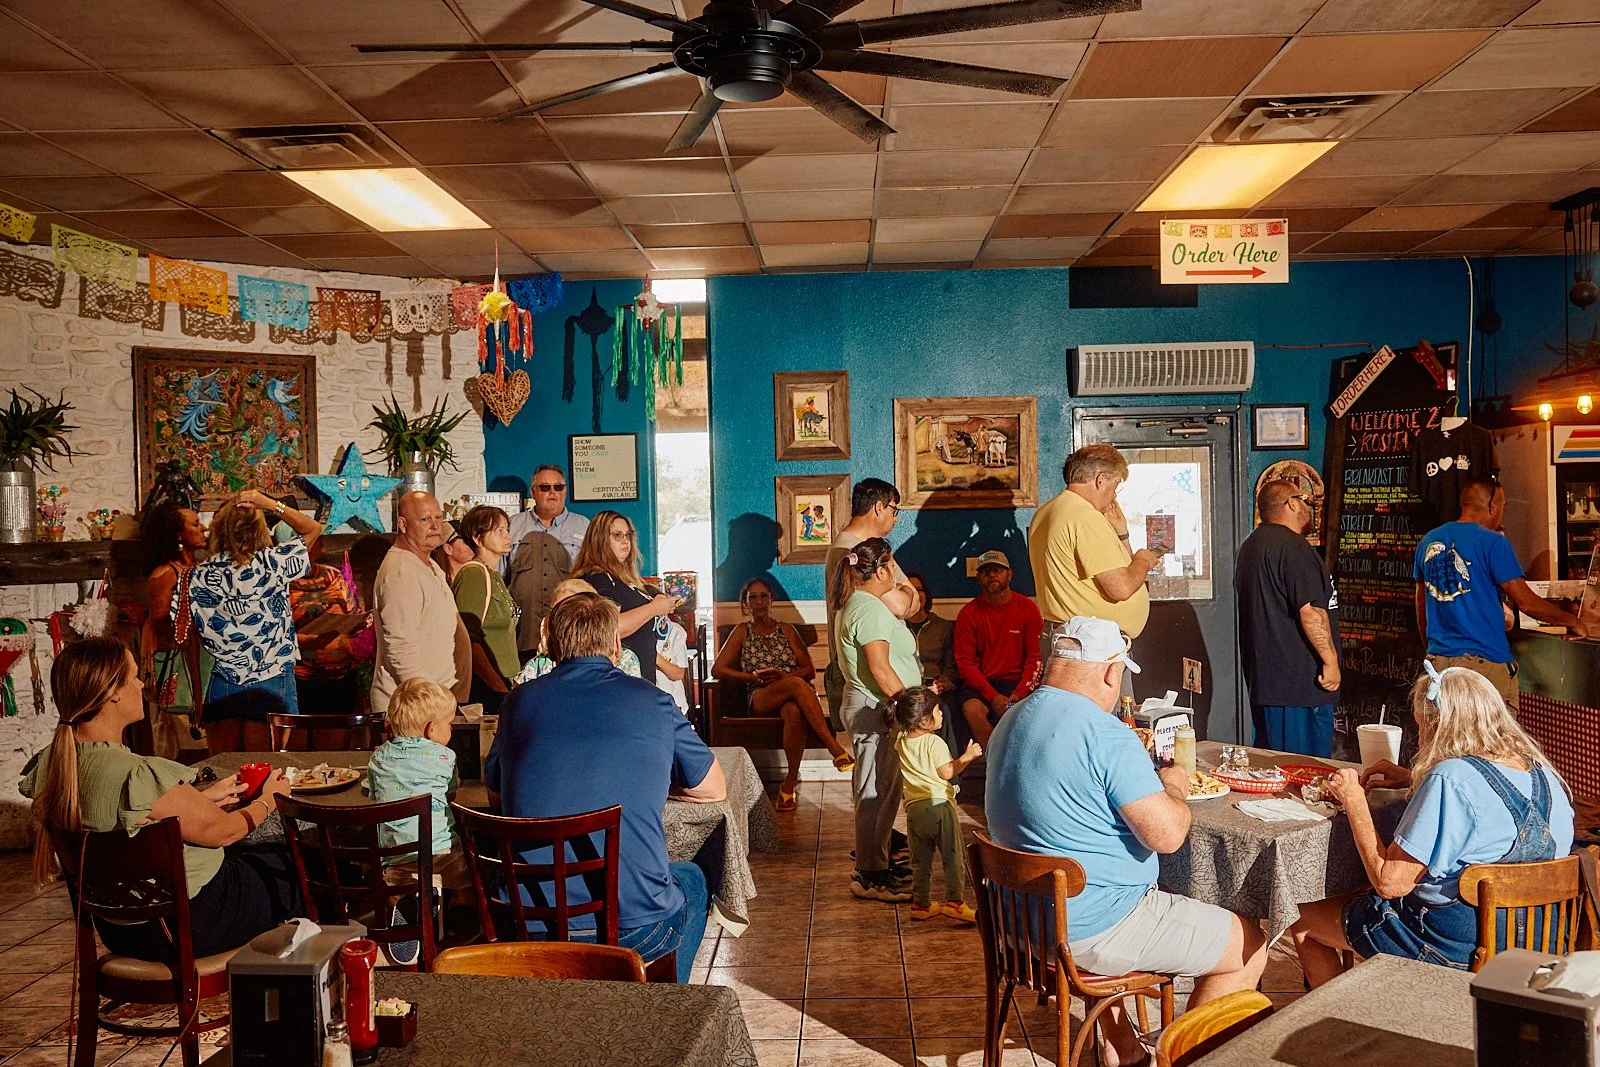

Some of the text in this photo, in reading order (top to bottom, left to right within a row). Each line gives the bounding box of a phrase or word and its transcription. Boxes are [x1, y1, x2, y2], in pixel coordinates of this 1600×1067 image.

[1171, 242, 1280, 265] Order Here
[1336, 353, 1388, 411] ORDER HERE
[1351, 411, 1420, 431] WELCOME
[1344, 467, 1394, 486] BREAKFAST
[1340, 514, 1374, 531] STREET
[1337, 558, 1372, 573] MEXICAN
[1378, 560, 1413, 578] POUTIN
[1188, 667, 1195, 685] 4
